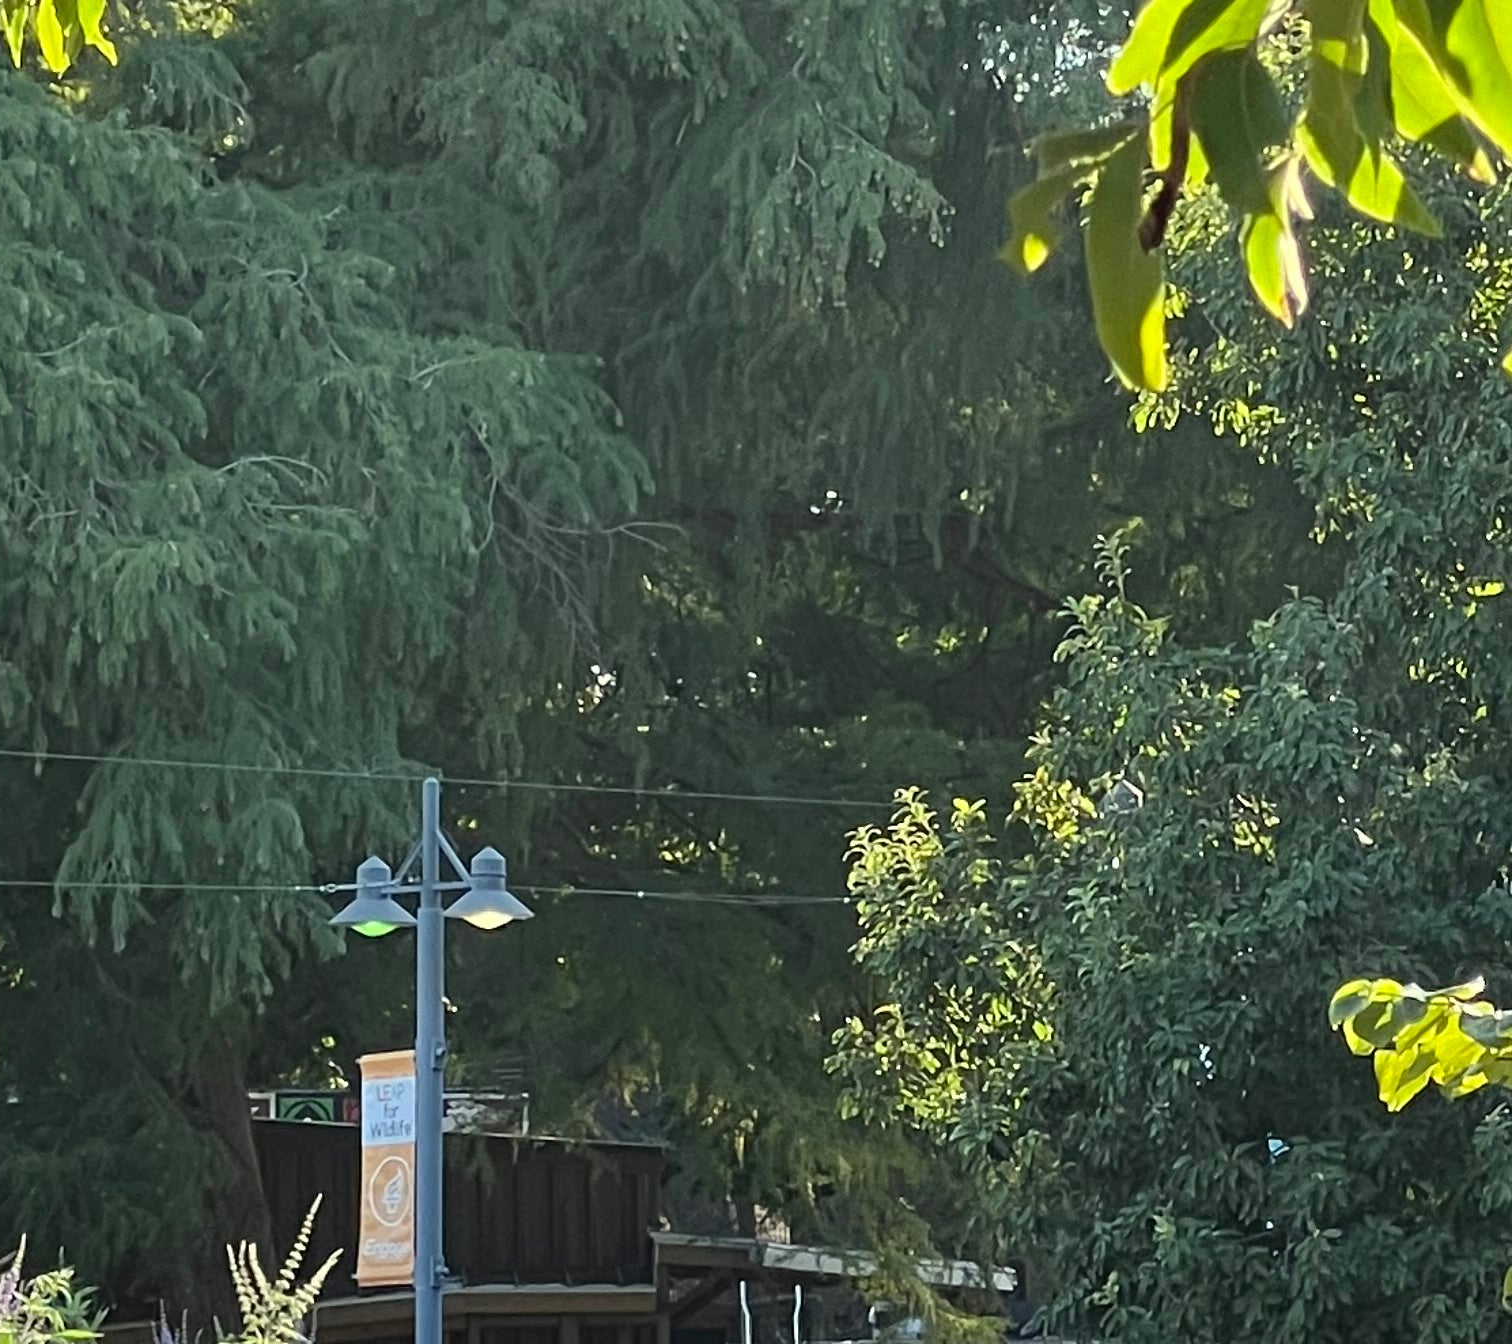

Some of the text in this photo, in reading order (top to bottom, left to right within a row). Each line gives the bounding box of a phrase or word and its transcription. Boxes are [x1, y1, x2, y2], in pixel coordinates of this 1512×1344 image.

[376, 1083, 405, 1101] LEAP
[383, 1103, 399, 1119] for
[369, 1120, 412, 1137] Wildlife
